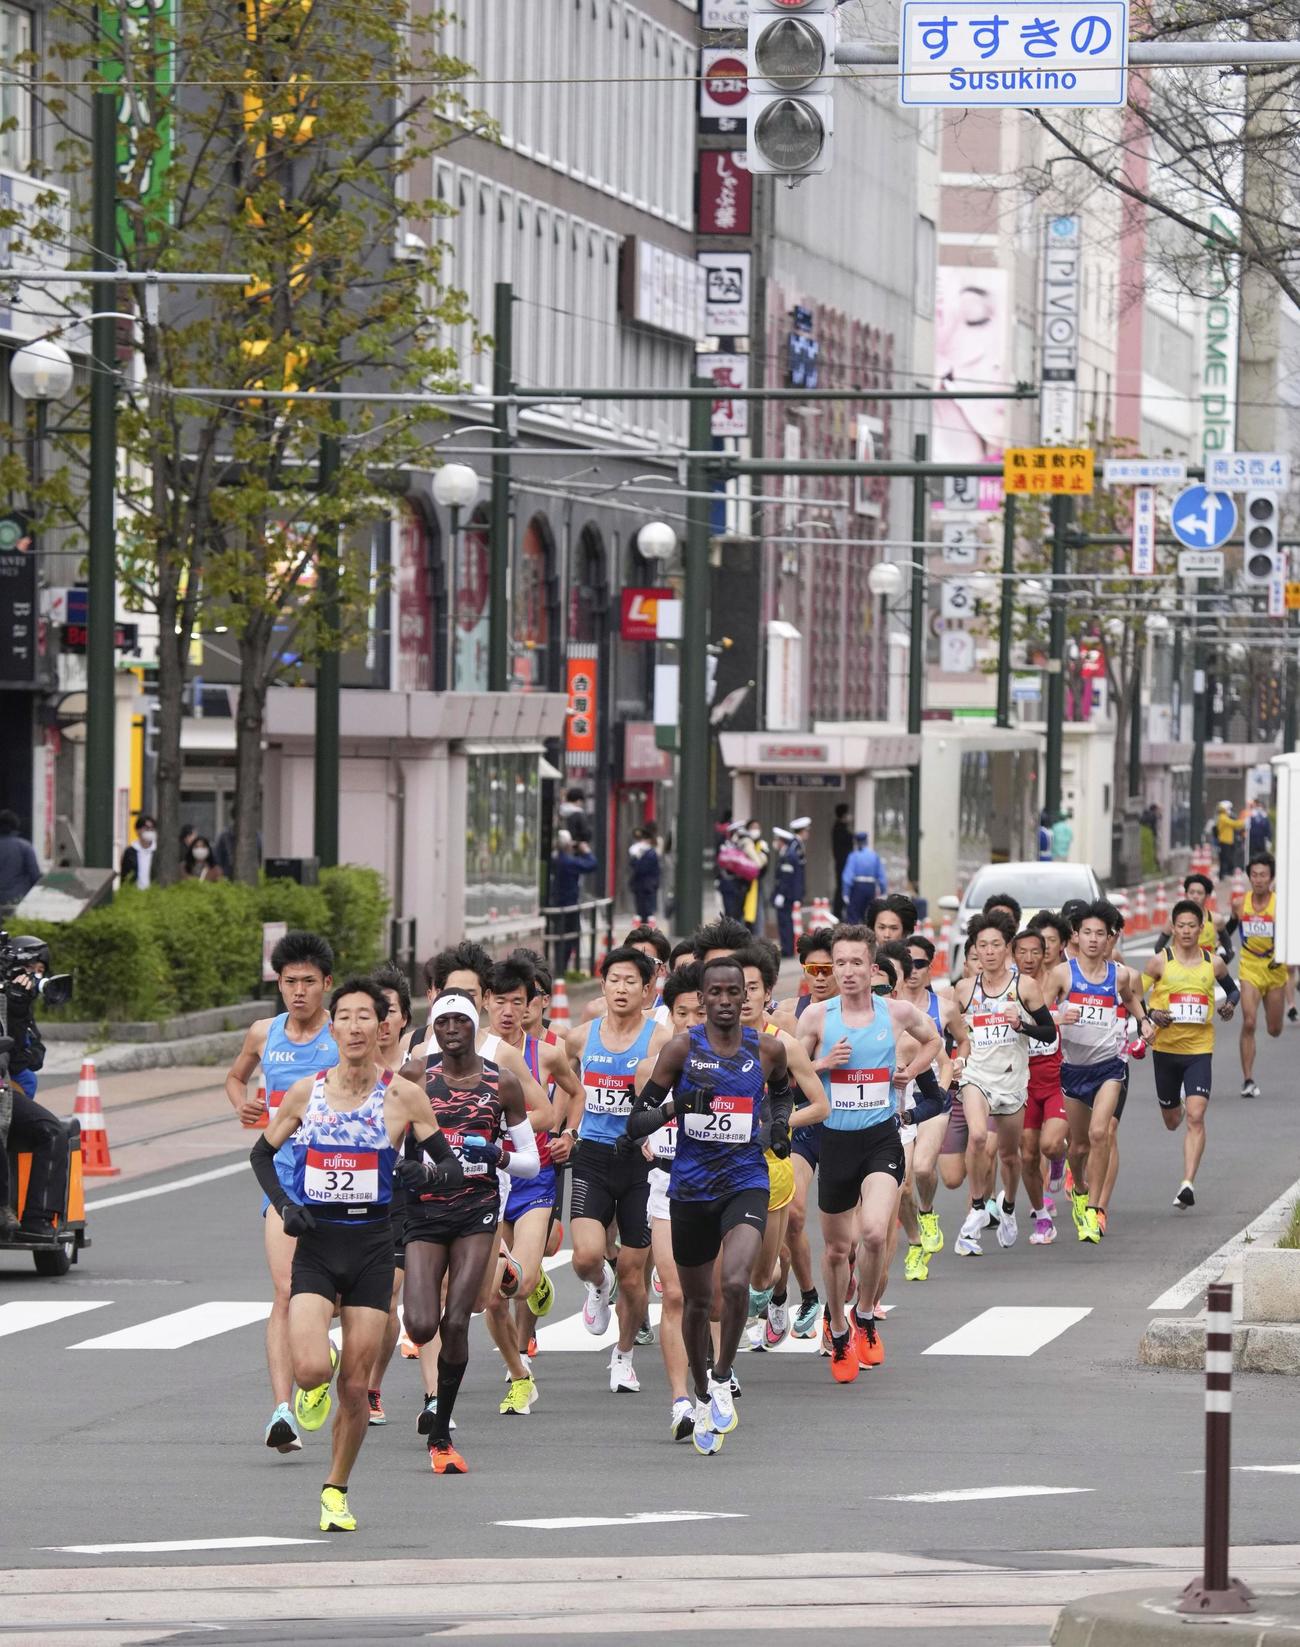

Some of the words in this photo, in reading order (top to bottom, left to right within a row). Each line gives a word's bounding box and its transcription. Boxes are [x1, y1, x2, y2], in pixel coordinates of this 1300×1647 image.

[917, 15, 1112, 59] すすきの
[949, 67, 1077, 90] Susukino
[1048, 261, 1076, 363] PIVOT
[1012, 453, 1086, 469] 軌道敷内
[1012, 474, 1085, 491] 通行禁止
[573, 675, 590, 735] 吉野家
[1079, 1006, 1104, 1021] 121
[1179, 1004, 1202, 1017] 114
[984, 1024, 1010, 1040] 147
[267, 1051, 296, 1063] YKK
[598, 1077, 624, 1088] FUJITSU
[848, 1071, 874, 1083] FUJITSU
[595, 1088, 628, 1106] 157
[856, 1084, 864, 1100] 1
[588, 1103, 605, 1112] DNP
[709, 1099, 735, 1111] UJITSU
[835, 1100, 856, 1109] DNP
[704, 1113, 732, 1131] 26
[688, 1129, 711, 1139] DNP
[323, 1155, 357, 1169] FUJITSU
[324, 1171, 355, 1191] 32
[308, 1187, 333, 1200] DNP
